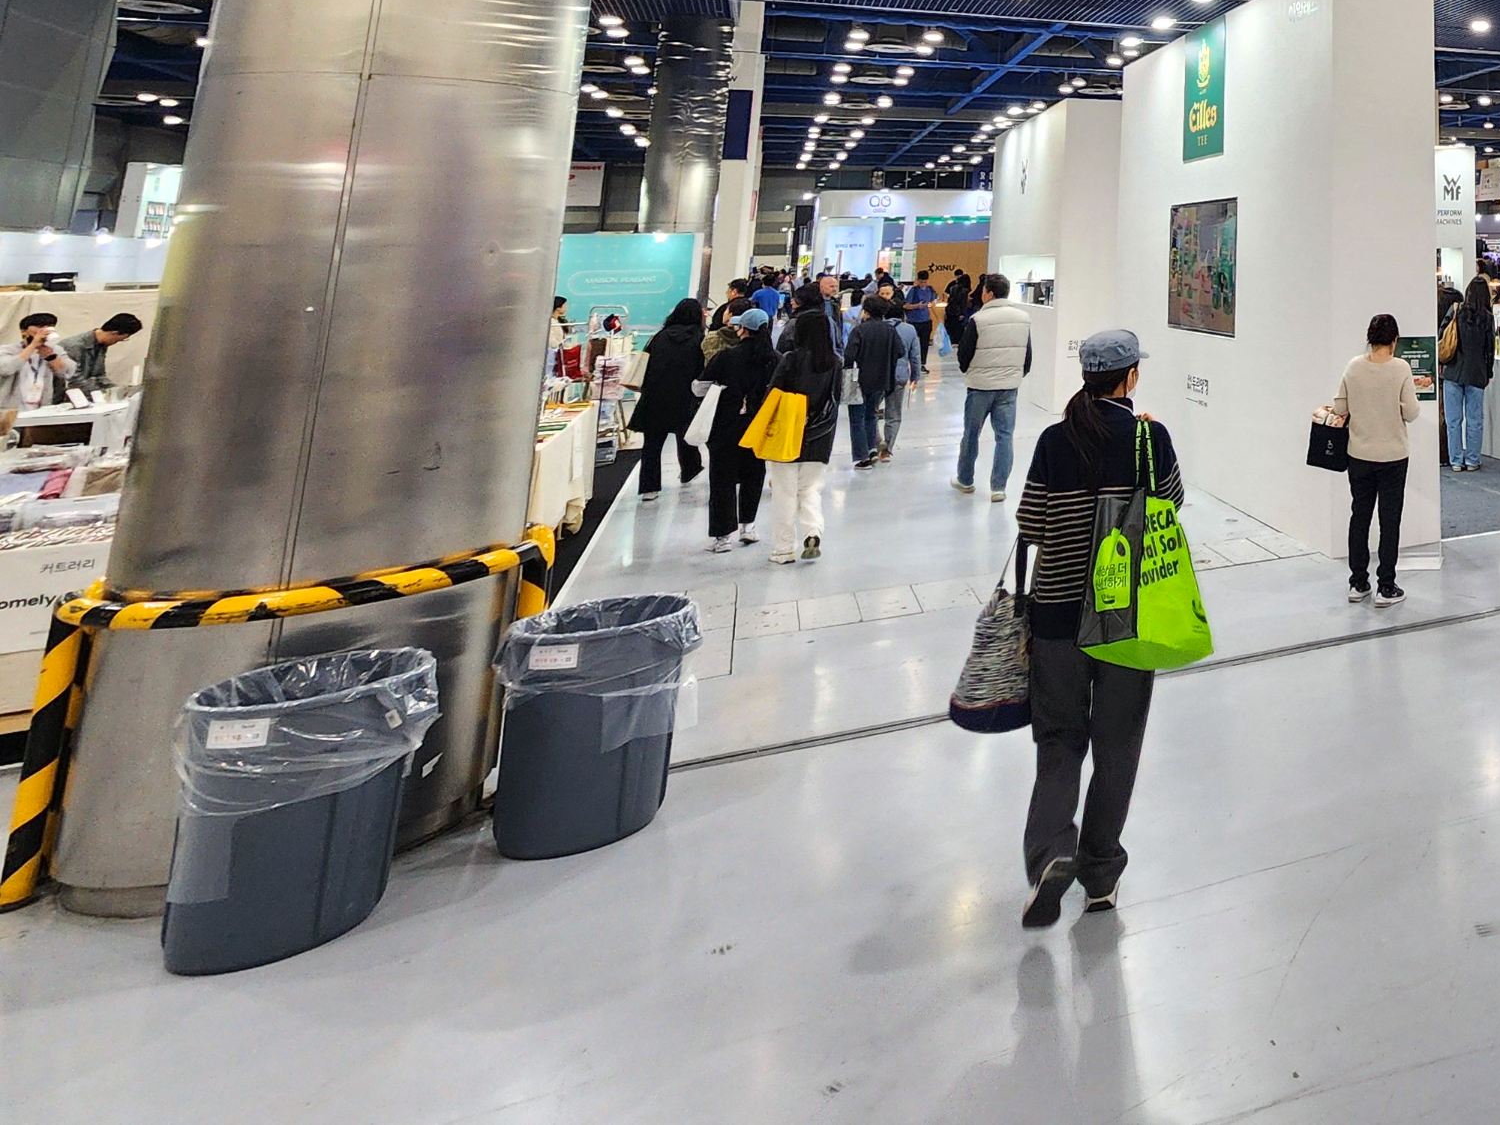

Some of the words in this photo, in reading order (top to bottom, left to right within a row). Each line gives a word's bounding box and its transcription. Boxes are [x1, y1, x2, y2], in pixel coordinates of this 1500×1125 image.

[1198, 135, 1208, 146] TEE
[39, 558, 95, 574] 커트러리
[1117, 562, 1127, 574] 더
